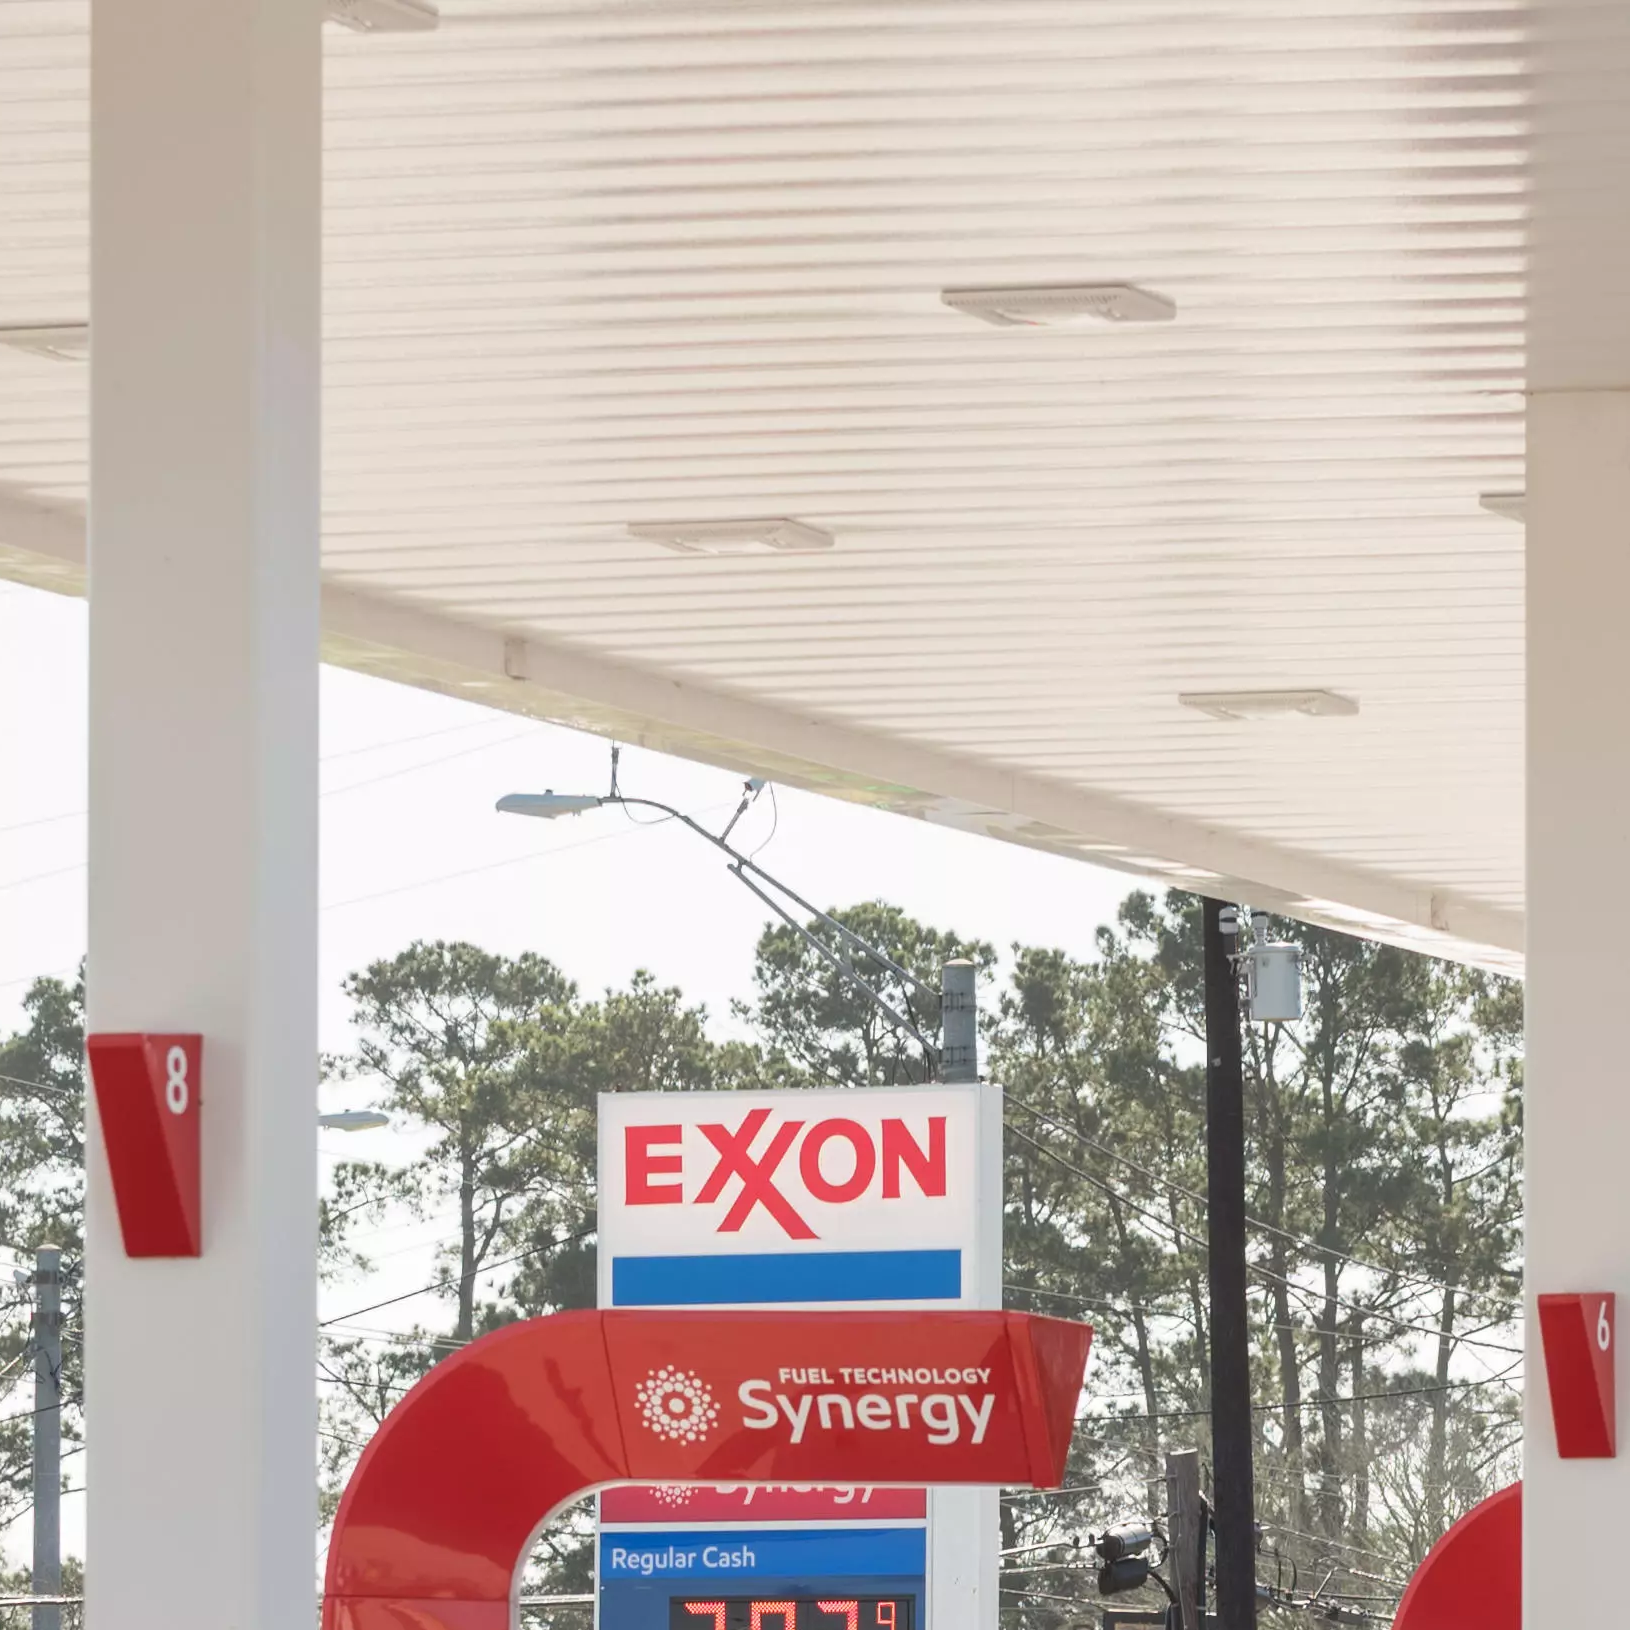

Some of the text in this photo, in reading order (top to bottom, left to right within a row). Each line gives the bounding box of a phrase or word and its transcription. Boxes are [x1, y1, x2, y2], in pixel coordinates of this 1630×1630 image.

[166, 1046, 188, 1115] 8
[624, 1108, 947, 1240] EXXON
[1597, 1301, 1610, 1351] 6
[779, 1368, 991, 1385] FUEL TECHNOLOGY
[737, 1380, 995, 1445] Synergy
[612, 1546, 756, 1575] Regular Cash
